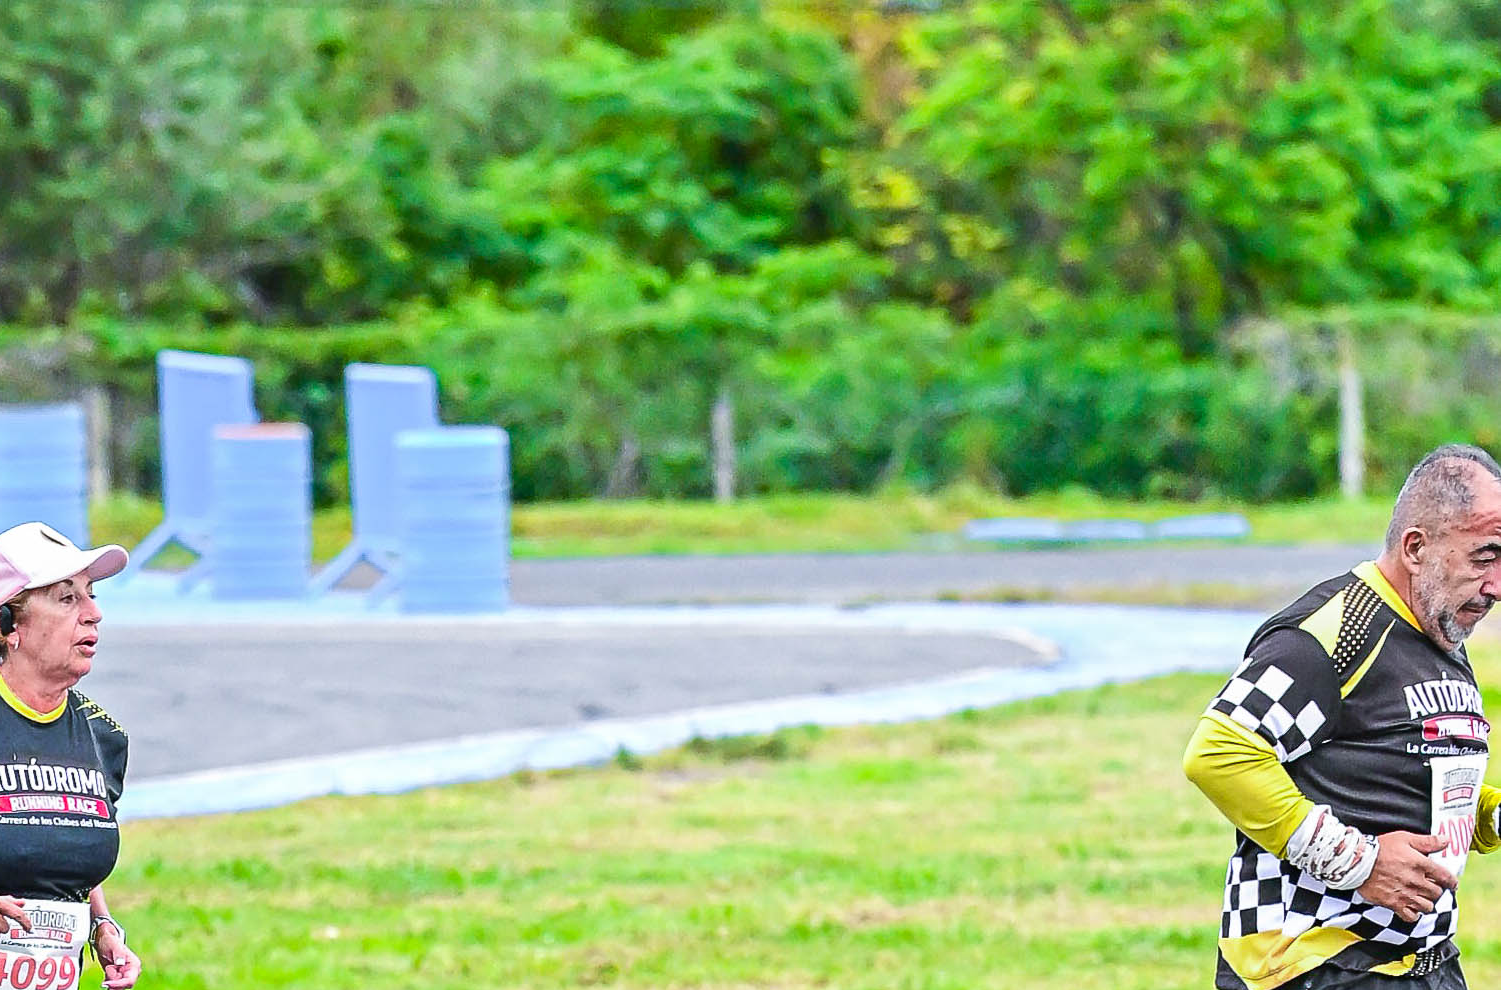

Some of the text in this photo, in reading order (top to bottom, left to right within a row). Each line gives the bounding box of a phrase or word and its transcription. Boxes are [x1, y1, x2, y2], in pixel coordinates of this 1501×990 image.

[1403, 671, 1484, 720] AUTÓDRO
[1407, 742, 1419, 753] La
[10, 795, 100, 815] RUNNING RACE
[28, 815, 40, 825] de
[40, 816, 53, 826] los
[53, 817, 80, 827] Clubes
[79, 818, 93, 828] del
[23, 905, 78, 931] TÓDROMO
